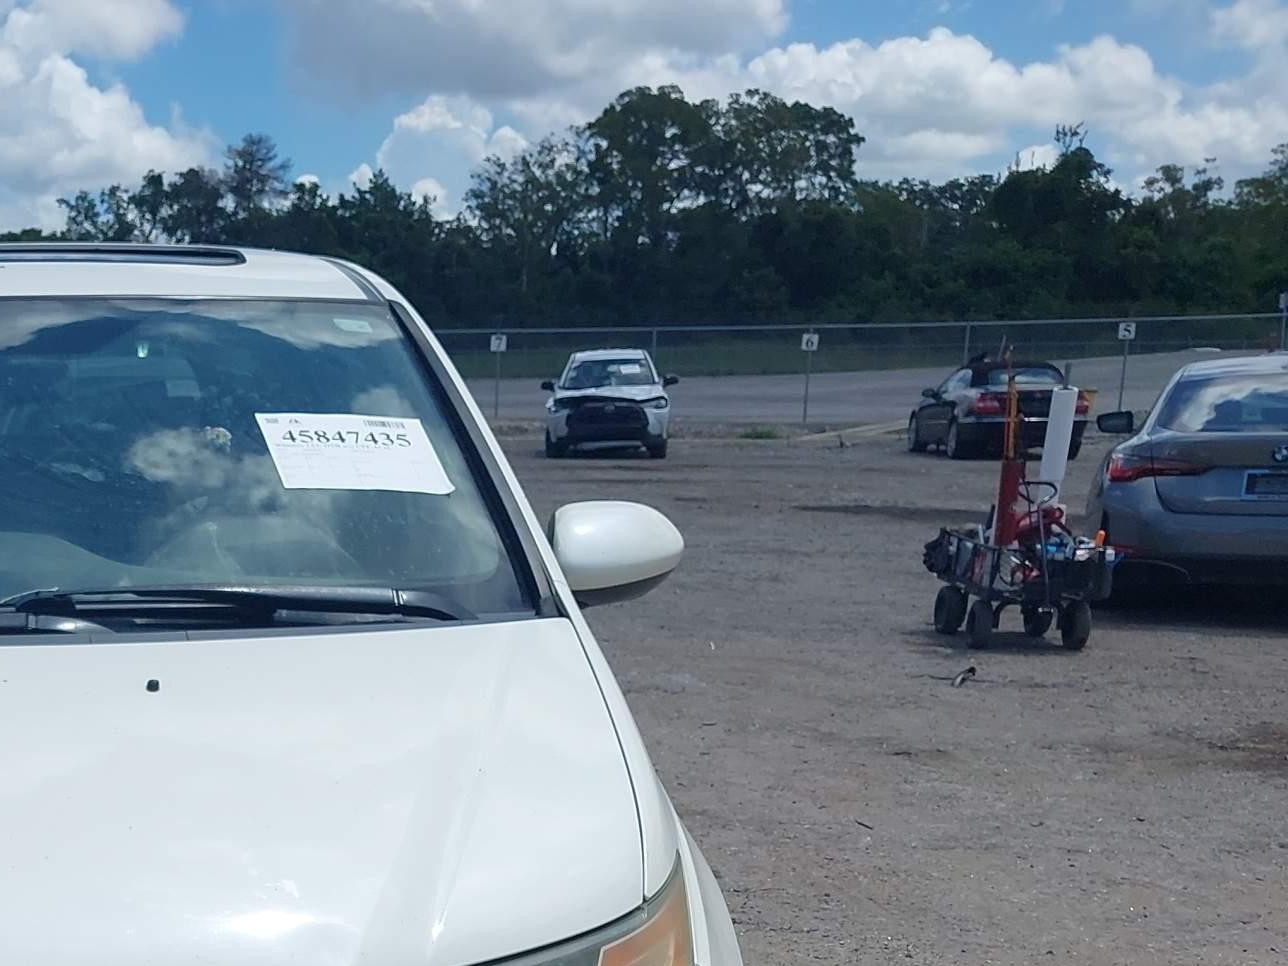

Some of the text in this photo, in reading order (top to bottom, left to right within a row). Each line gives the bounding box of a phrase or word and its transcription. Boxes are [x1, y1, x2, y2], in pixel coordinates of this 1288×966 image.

[1122, 323, 1132, 338] 5
[805, 336, 815, 350] 6
[282, 430, 412, 448] 45847435
